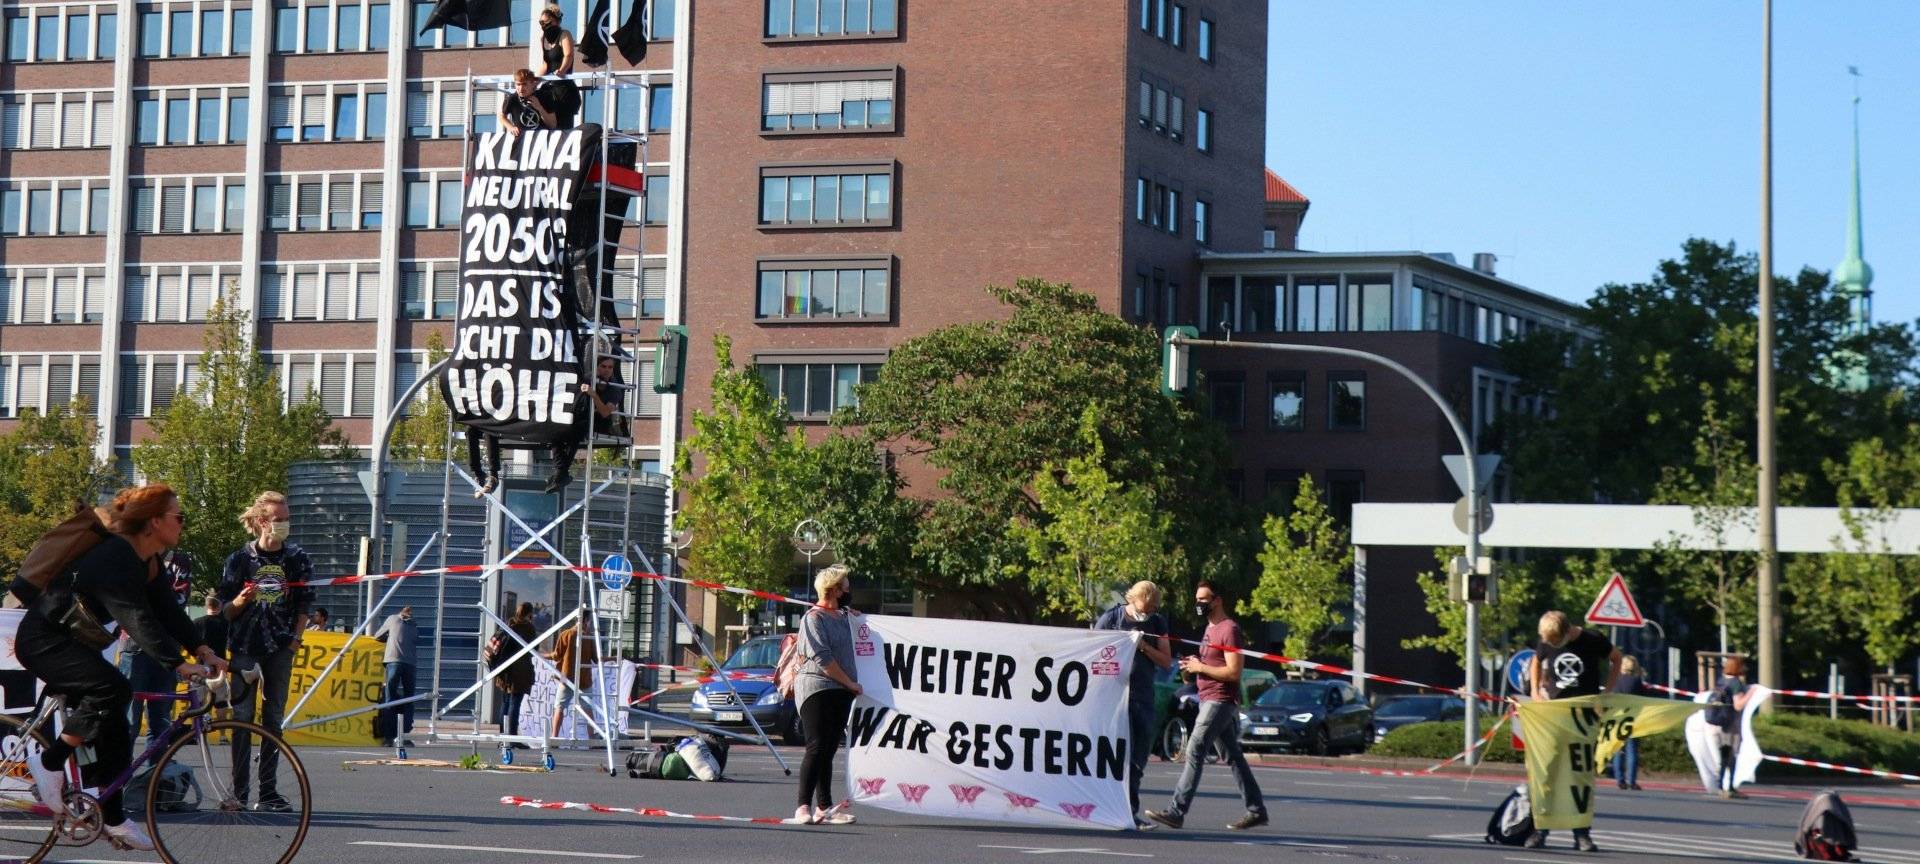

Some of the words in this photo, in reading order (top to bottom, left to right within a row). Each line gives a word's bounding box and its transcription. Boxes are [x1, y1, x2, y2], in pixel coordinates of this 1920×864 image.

[467, 175, 573, 211] NEUTRAL
[461, 278, 519, 320] DAS
[448, 362, 578, 425] HÖHE
[883, 642, 1017, 700] WEITER
[1031, 656, 1089, 706] SO
[850, 705, 936, 754] WAR
[945, 720, 1127, 782] GESTERN
